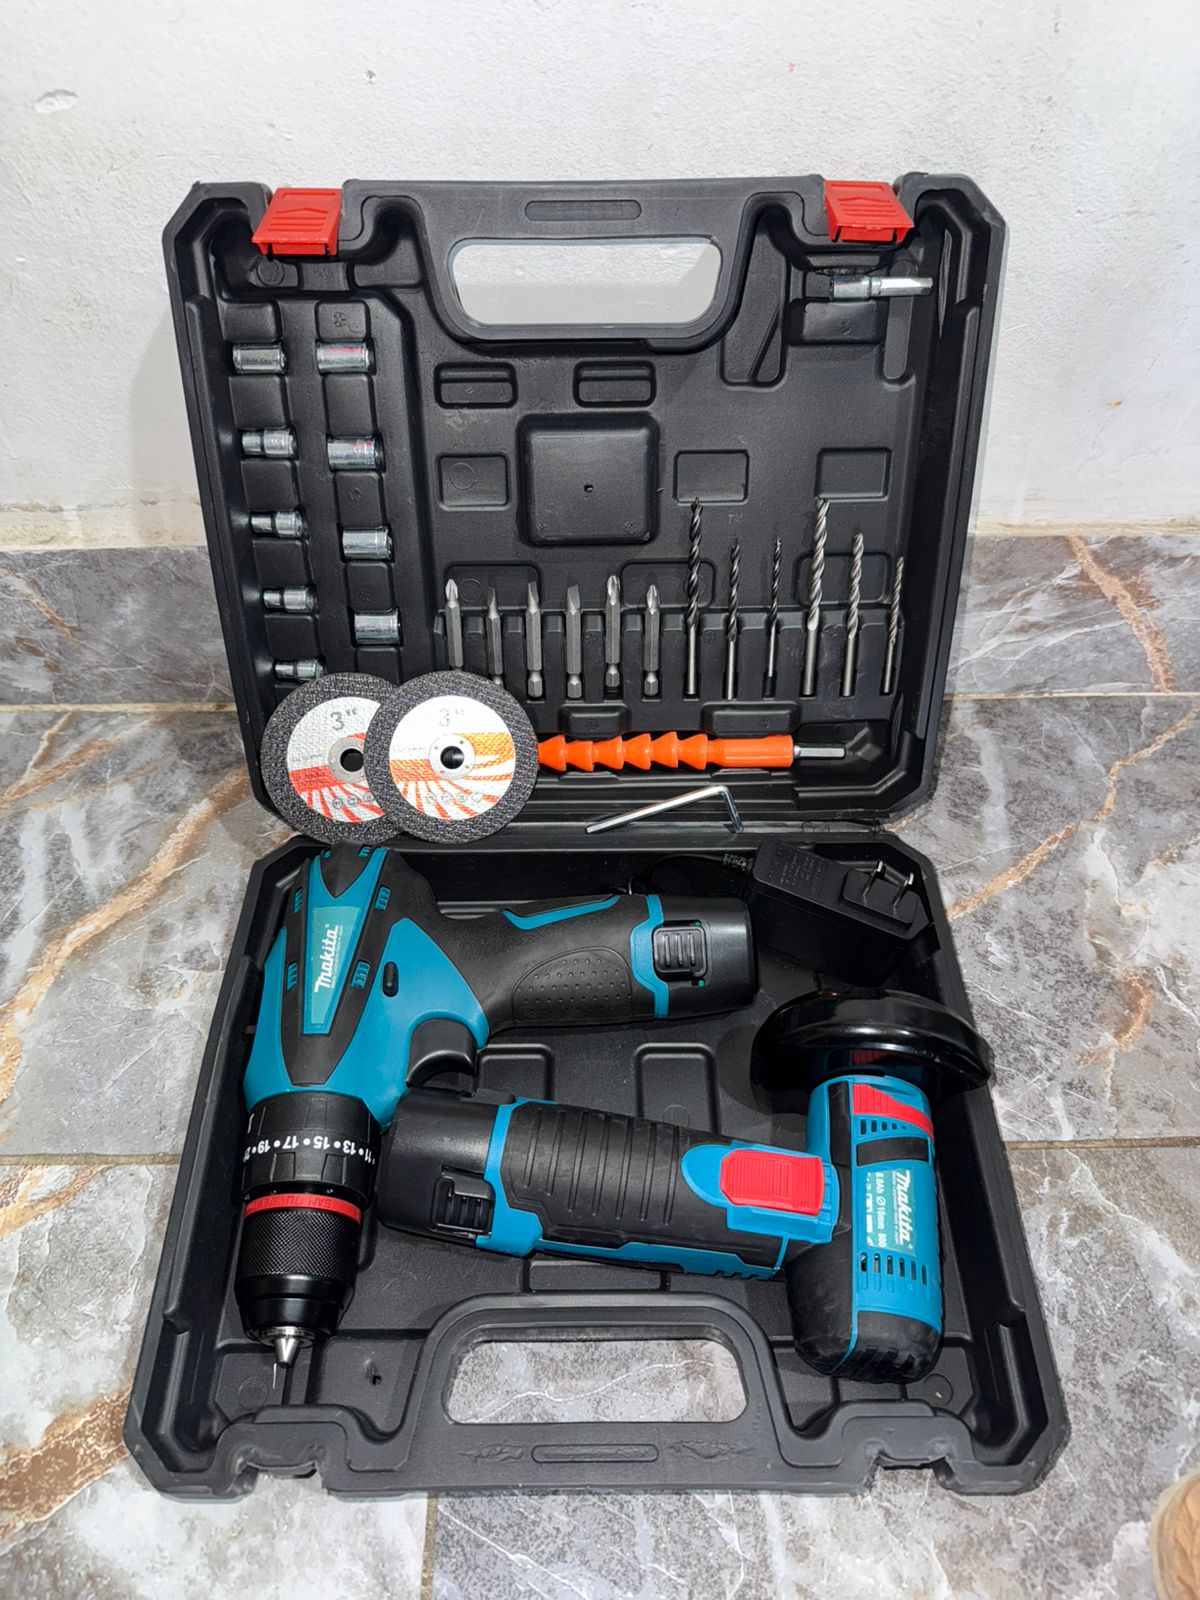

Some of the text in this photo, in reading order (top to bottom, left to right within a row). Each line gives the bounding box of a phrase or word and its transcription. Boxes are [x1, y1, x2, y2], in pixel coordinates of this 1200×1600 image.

[257, 1139, 271, 1155] 19
[282, 1135, 299, 1150] 17
[313, 1135, 331, 1150] 15
[343, 1140, 357, 1156] 13
